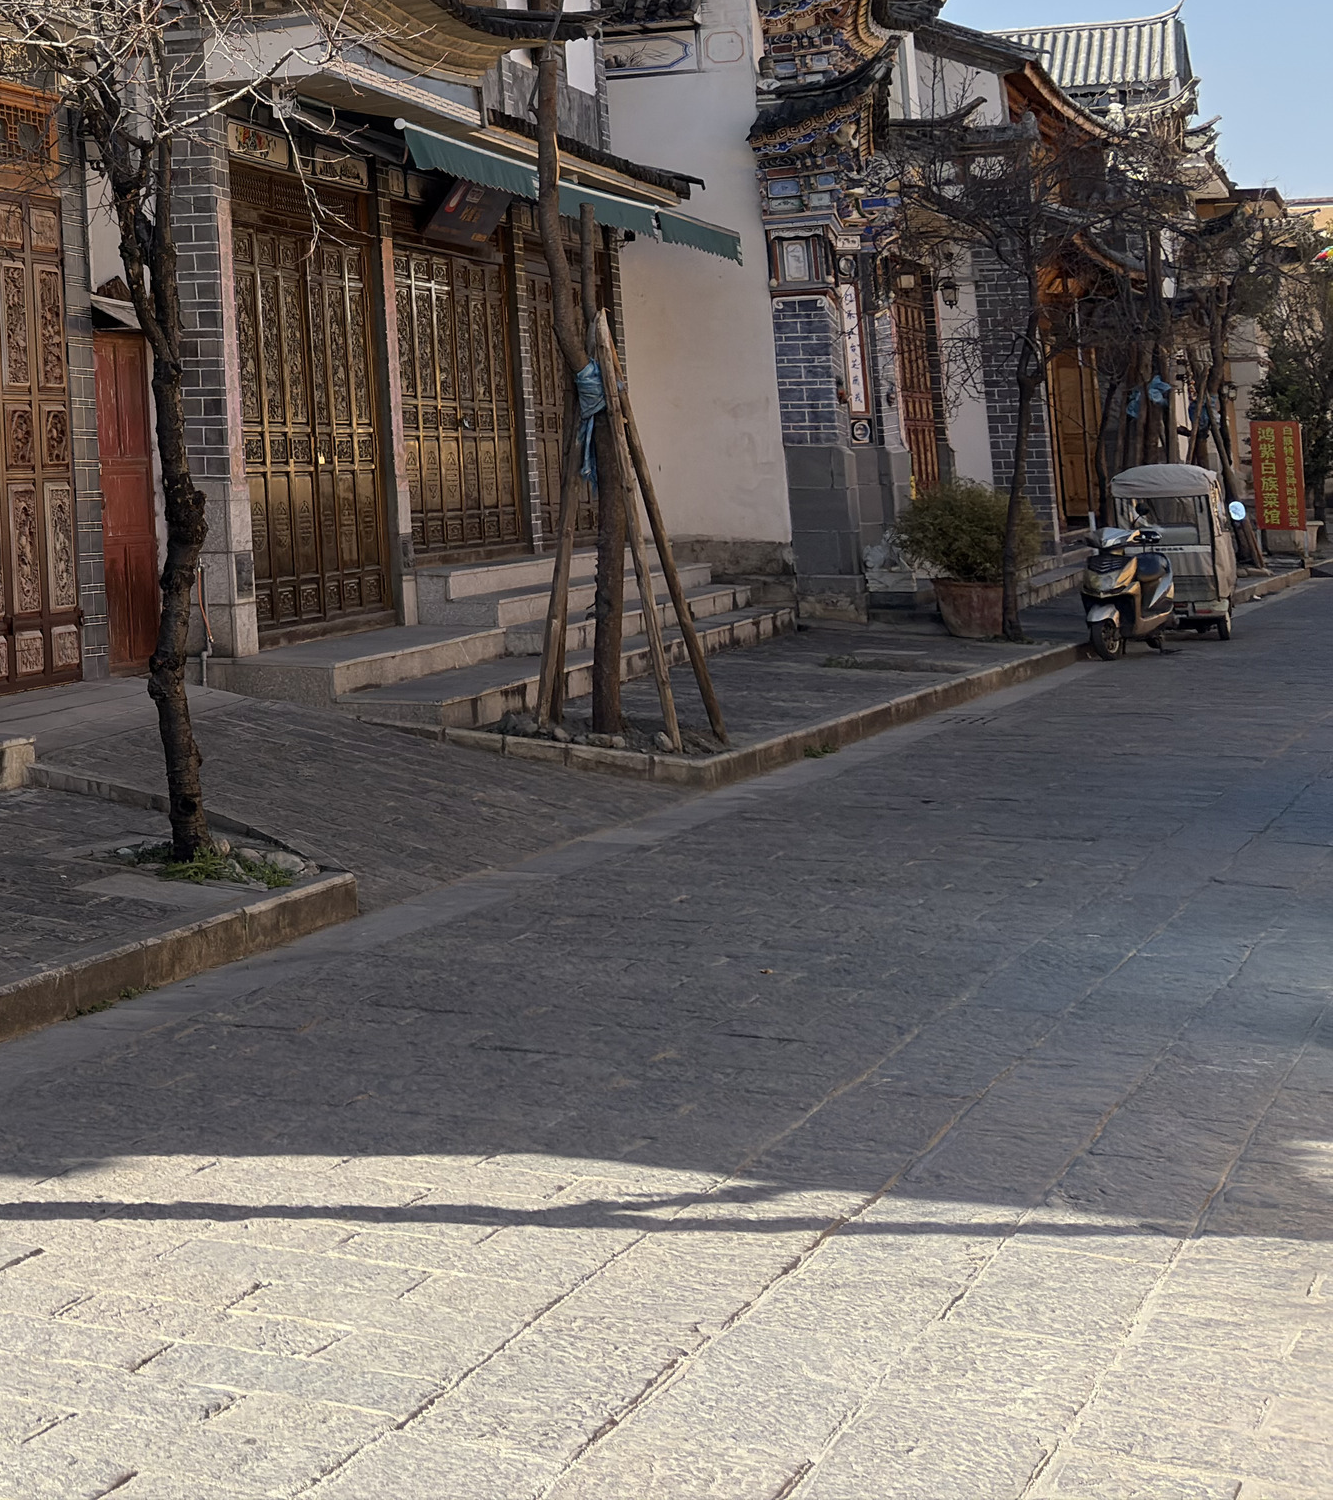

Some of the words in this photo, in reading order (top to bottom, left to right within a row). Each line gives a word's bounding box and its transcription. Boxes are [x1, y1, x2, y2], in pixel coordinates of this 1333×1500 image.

[1257, 426, 1281, 525] 鸿紫白族菜馆
